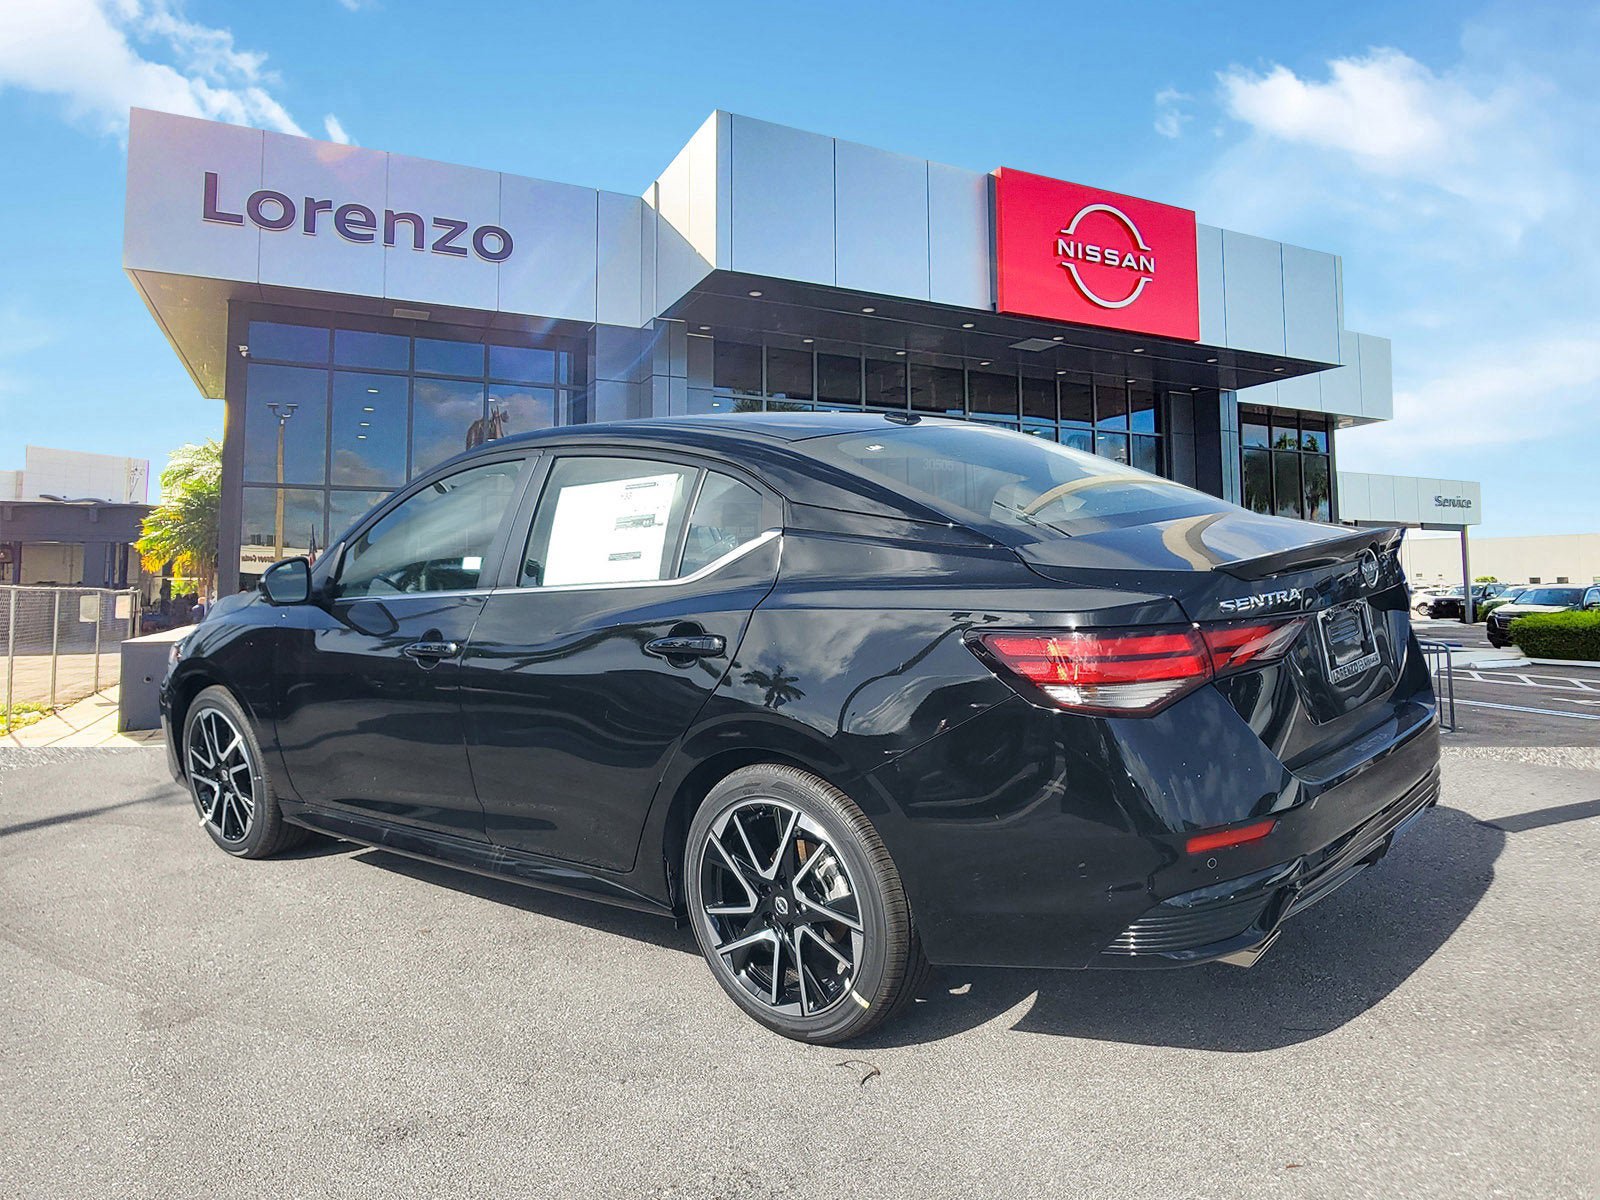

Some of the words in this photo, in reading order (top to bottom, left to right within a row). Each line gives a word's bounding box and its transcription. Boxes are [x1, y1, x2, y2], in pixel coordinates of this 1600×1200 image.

[202, 171, 514, 263] Lorenzo
[1057, 238, 1155, 273] NISSAN
[1434, 495, 1472, 508] Service
[1219, 588, 1302, 613] SENTRA
